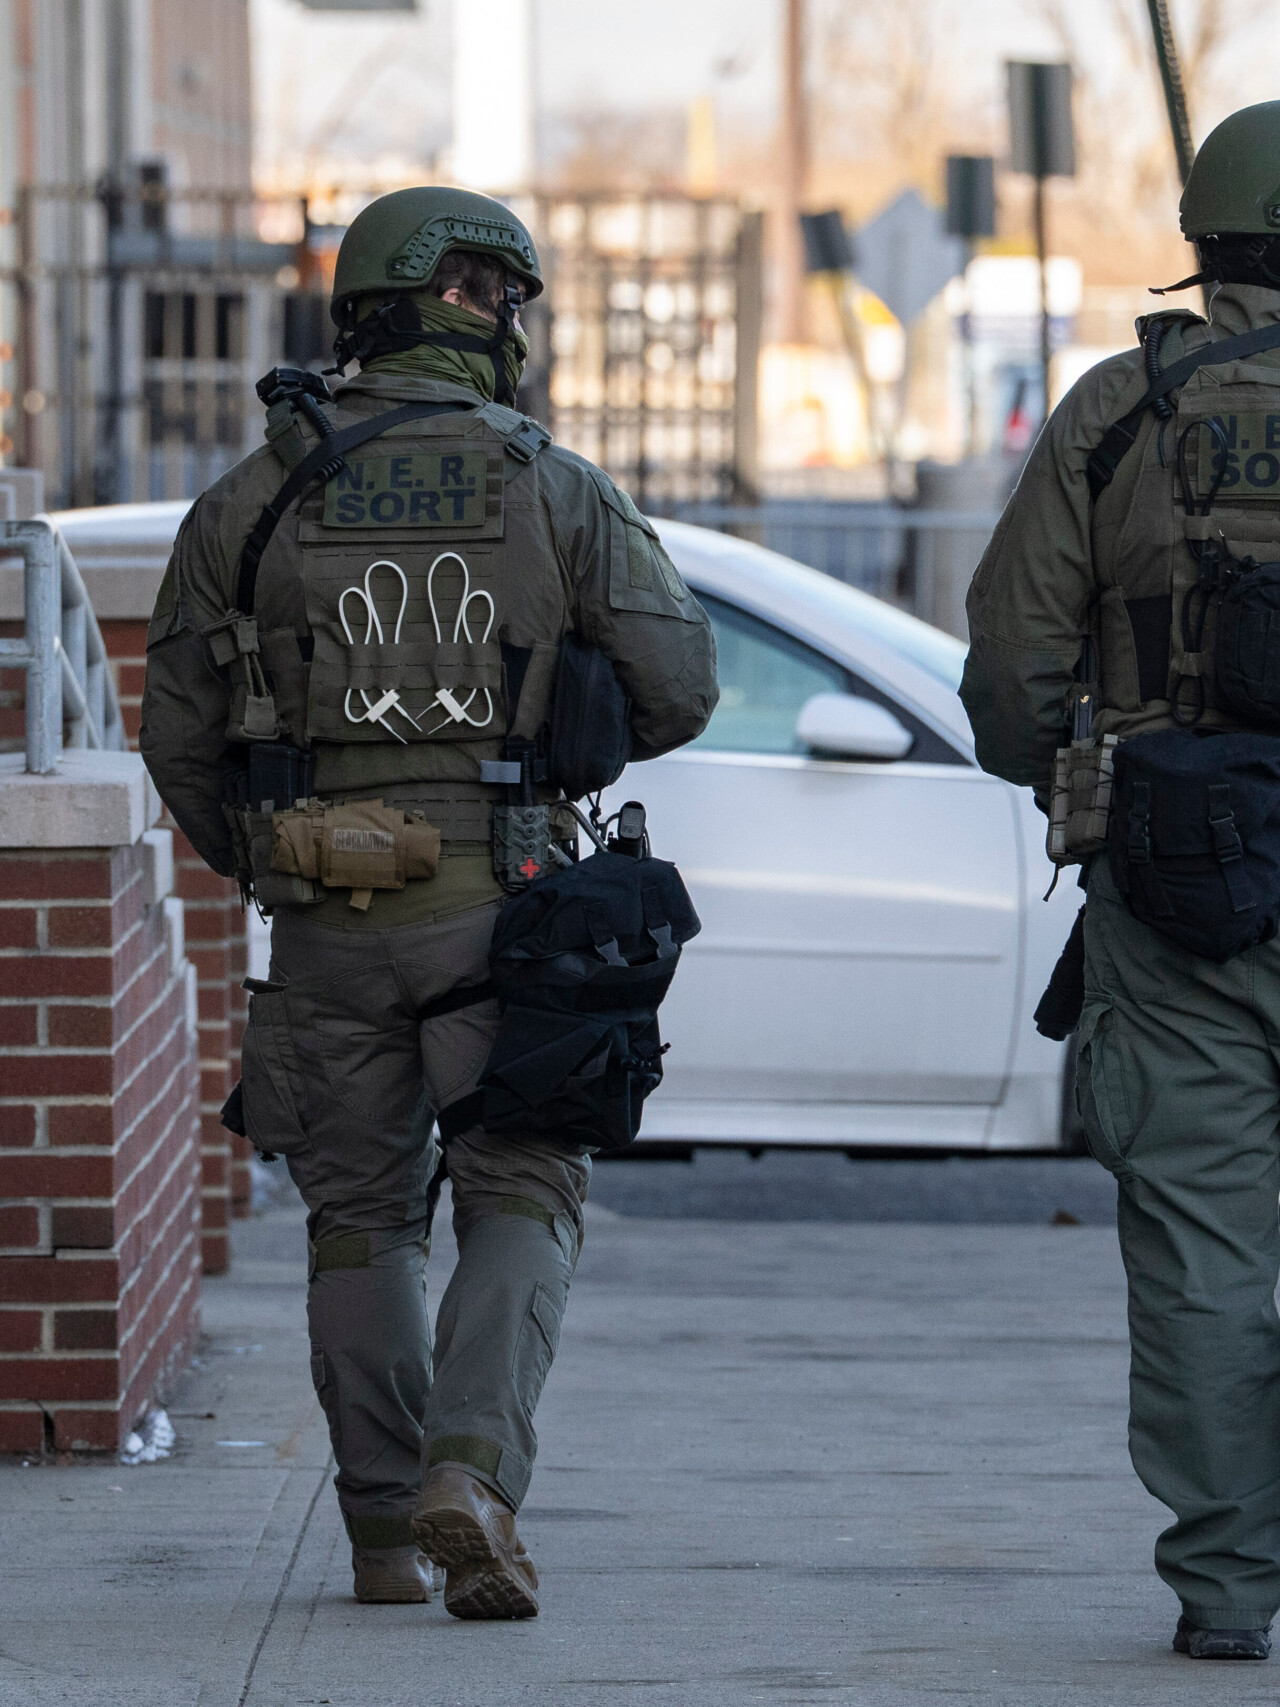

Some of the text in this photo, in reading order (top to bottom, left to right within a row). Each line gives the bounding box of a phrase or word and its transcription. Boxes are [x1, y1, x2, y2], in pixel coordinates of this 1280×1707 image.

[1210, 414, 1250, 450] N.
[336, 455, 476, 491] N. E. R.
[335, 488, 476, 524] SORT
